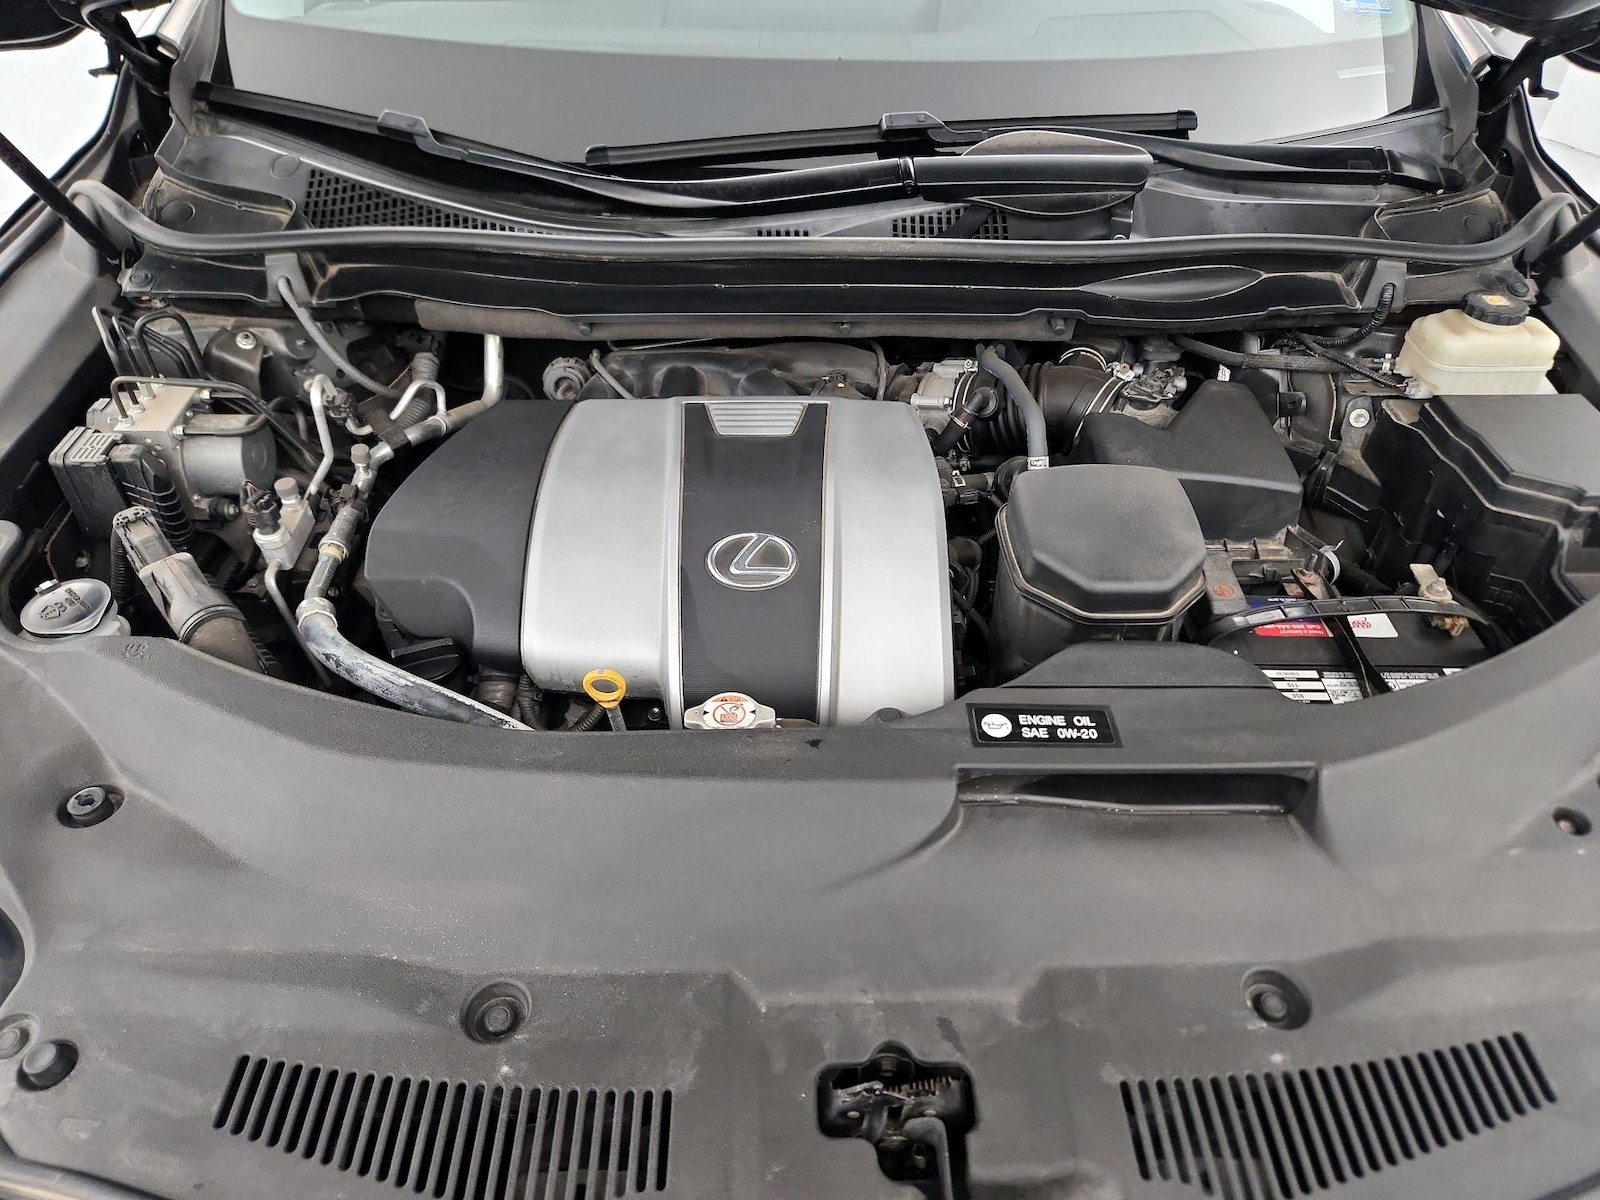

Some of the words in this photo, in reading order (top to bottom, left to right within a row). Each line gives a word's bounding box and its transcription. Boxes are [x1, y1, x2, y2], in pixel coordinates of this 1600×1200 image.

[1018, 714, 1067, 726] ENGINE
[1072, 715, 1097, 727] OIL
[1021, 727, 1049, 739] SAE
[1057, 728, 1098, 739] 0W-20
